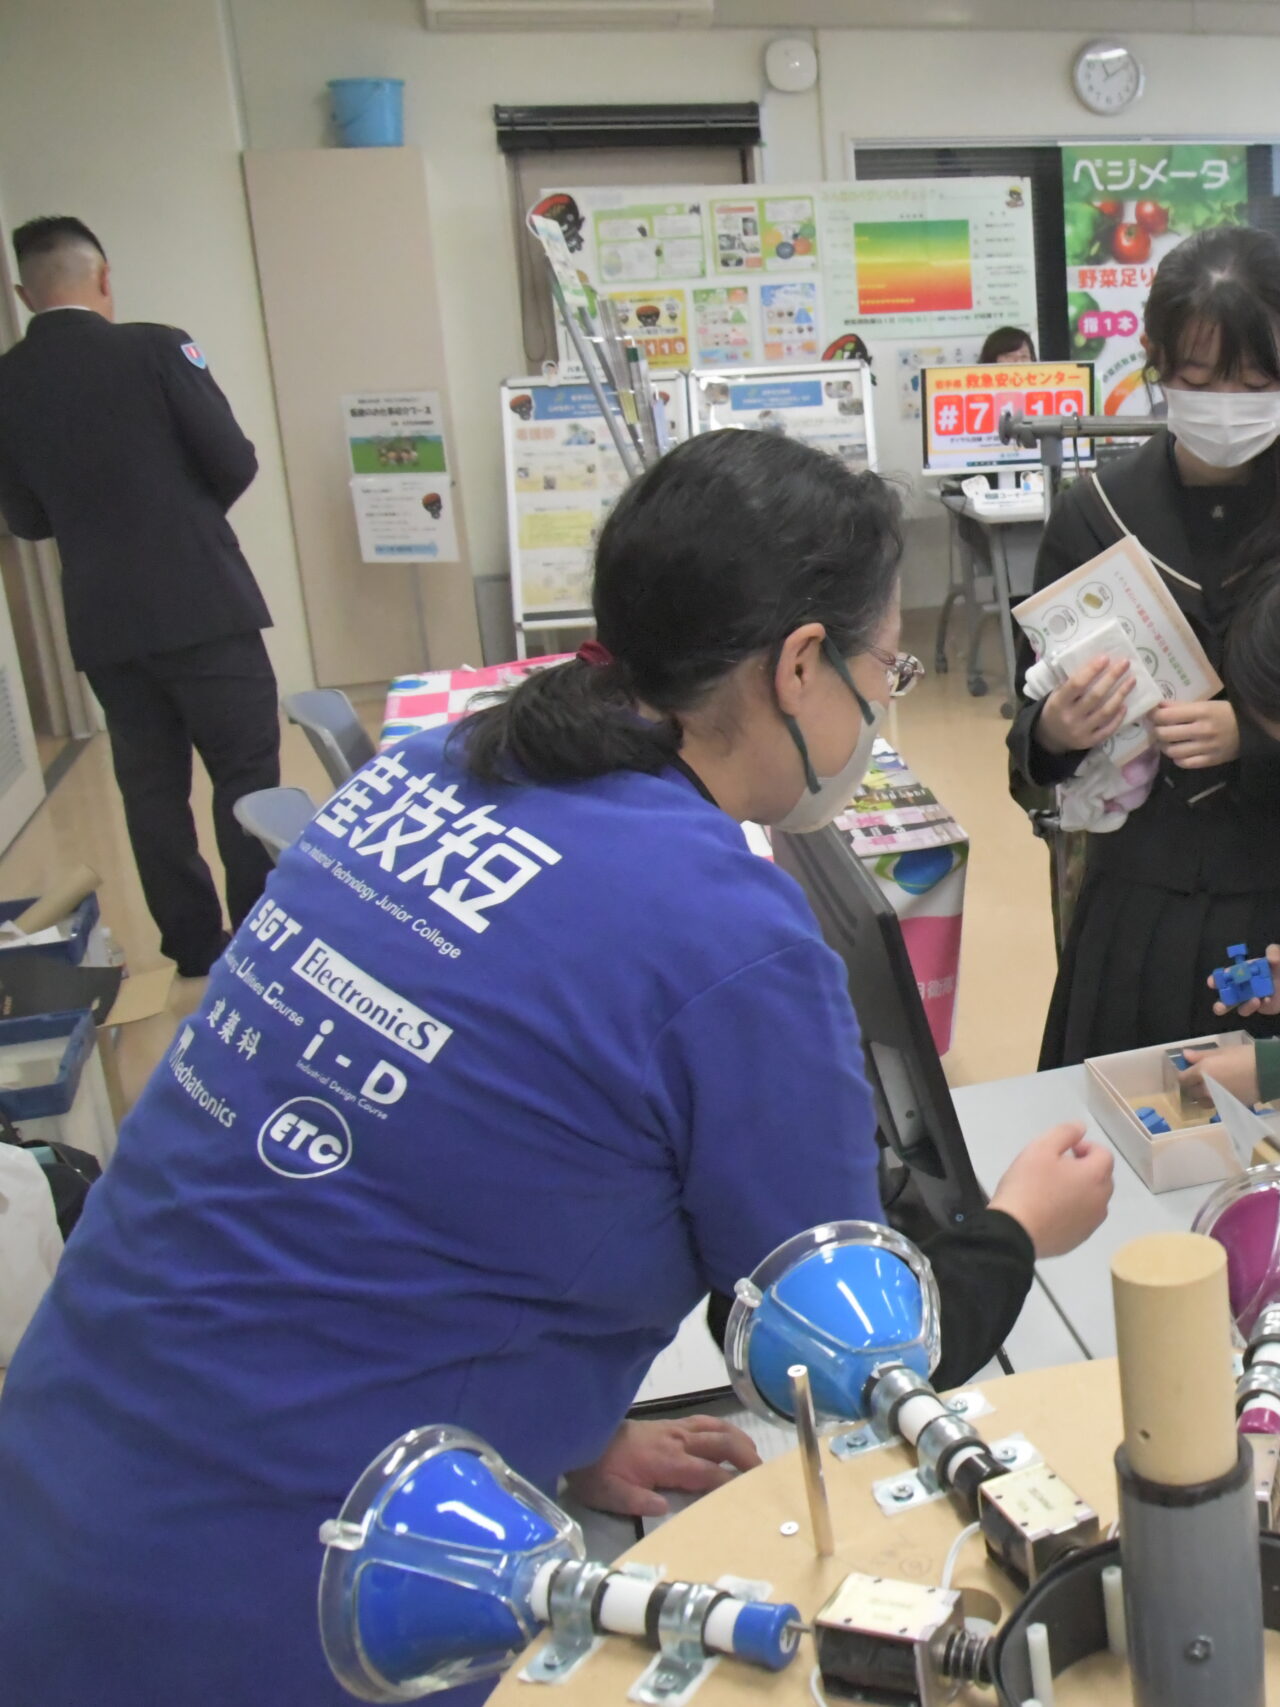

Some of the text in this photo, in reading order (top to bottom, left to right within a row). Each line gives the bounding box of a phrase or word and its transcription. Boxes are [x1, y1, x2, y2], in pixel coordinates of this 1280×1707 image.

[966, 371, 1080, 389] 救急安心センター
[249, 899, 302, 951] SGT
[331, 861, 378, 901] Technology
[375, 895, 414, 925] Junior
[411, 918, 462, 959] College
[206, 998, 262, 1060] 建築科
[262, 981, 305, 1027] Course
[329, 1079, 357, 1104] Design
[357, 1098, 388, 1121] Course
[270, 1112, 342, 1165] ETC
